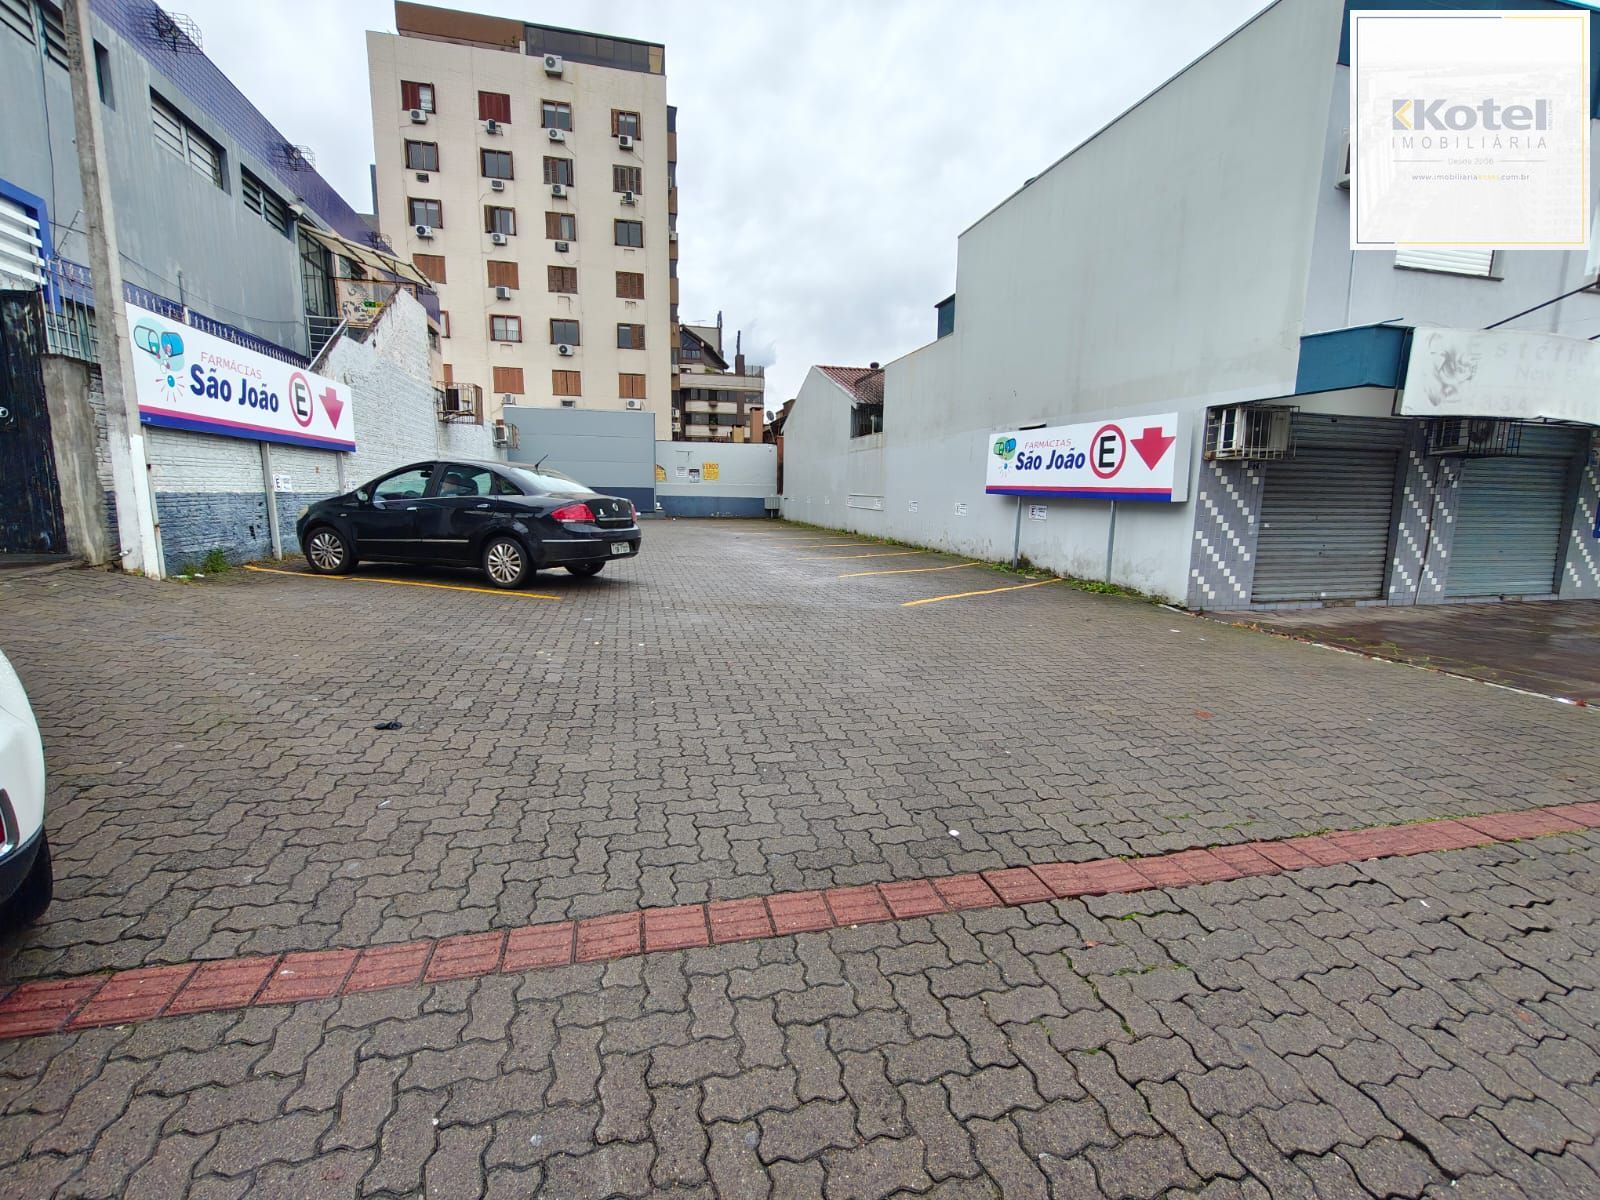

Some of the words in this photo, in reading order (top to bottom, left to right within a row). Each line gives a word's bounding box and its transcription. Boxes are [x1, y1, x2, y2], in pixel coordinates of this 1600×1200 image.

[201, 352, 263, 380] FARMÁCIAS
[190, 363, 232, 402] São
[238, 378, 279, 413] João
[294, 382, 308, 417] E
[1015, 450, 1043, 470] São
[1045, 447, 1086, 470] João
[1098, 435, 1117, 468] E
